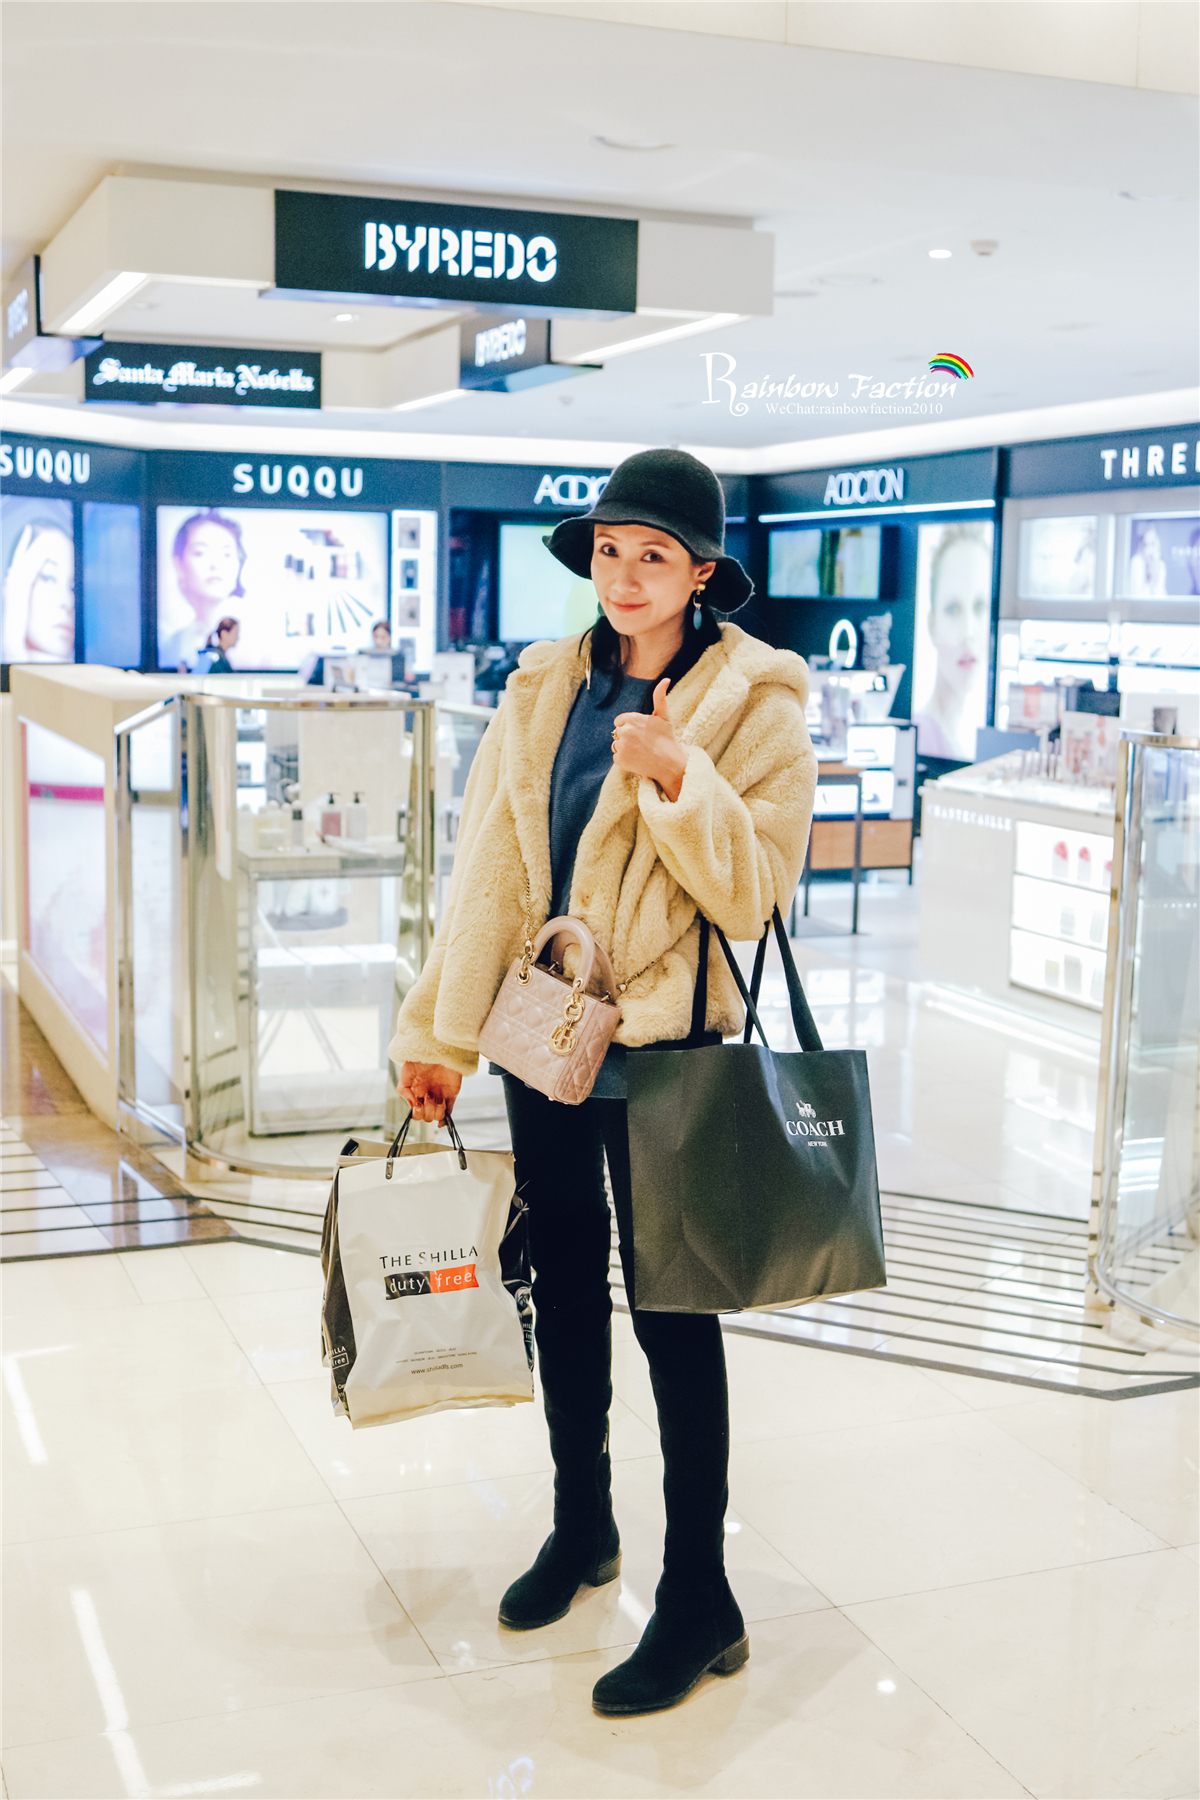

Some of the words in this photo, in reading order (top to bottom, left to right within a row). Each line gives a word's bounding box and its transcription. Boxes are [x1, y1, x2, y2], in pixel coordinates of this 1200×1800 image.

[364, 222, 557, 283] BYREDO
[92, 357, 165, 385] Santa
[162, 361, 236, 392] Maria
[0, 444, 91, 485] SUQQU
[1100, 440, 1200, 480] THRE
[233, 463, 364, 499] SUQQU
[786, 1120, 845, 1137] COACH
[379, 1255, 412, 1269] THE
[419, 1246, 478, 1264] SHILLA
[389, 1277, 425, 1293] duty
[435, 1272, 472, 1287] free
